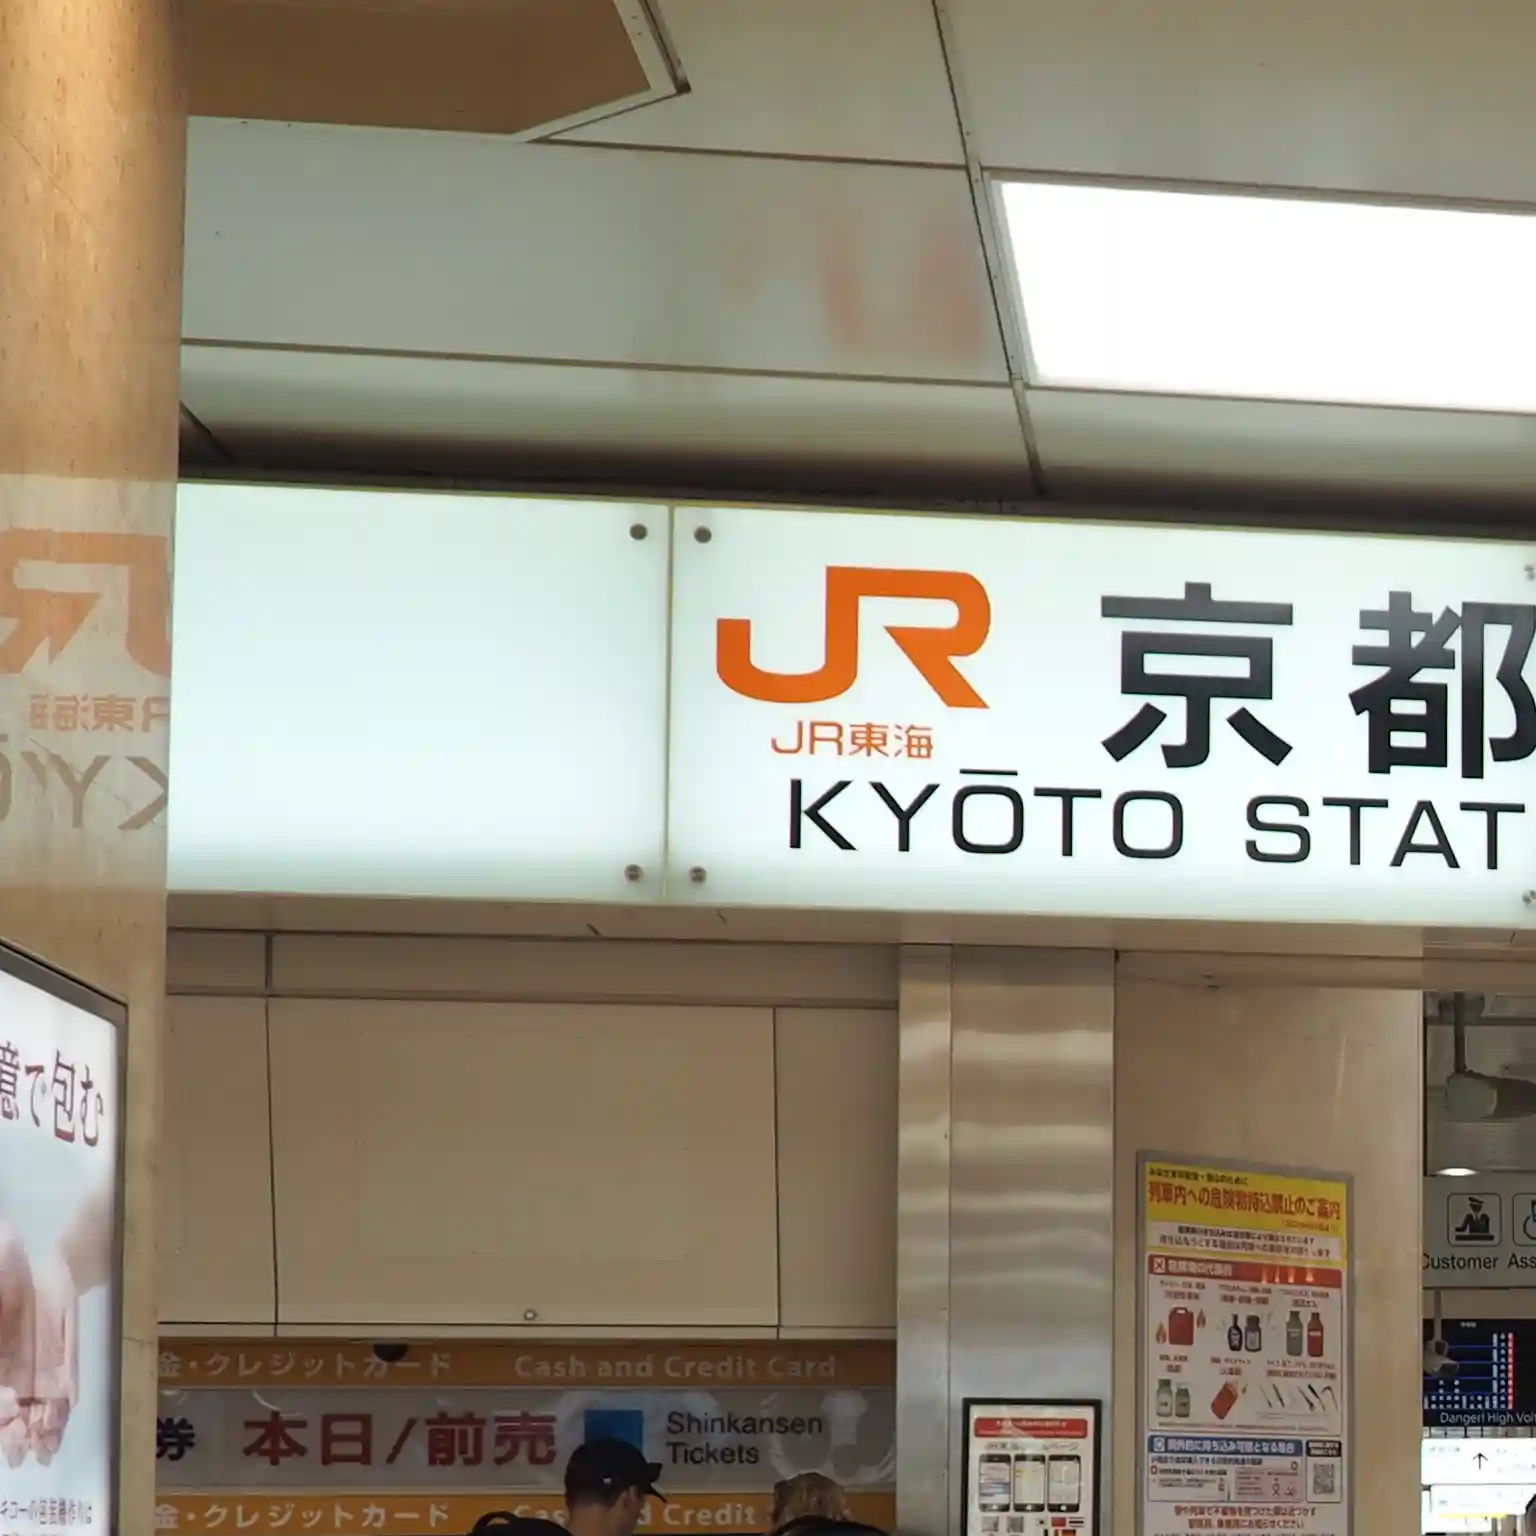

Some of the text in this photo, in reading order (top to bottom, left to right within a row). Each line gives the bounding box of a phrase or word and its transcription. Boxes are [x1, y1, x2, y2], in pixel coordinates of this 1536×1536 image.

[717, 567, 990, 708] JR
[770, 719, 934, 761] JR東海
[790, 770, 1183, 858] KYŌTO
[513, 1354, 837, 1379] Cash and Credit Card
[665, 1411, 823, 1436] Shinkansen
[1488, 1412, 1511, 1426] High
[242, 1411, 558, 1466] 本日/前売
[665, 1440, 760, 1465] Tickets
[662, 1503, 755, 1526] Credit
